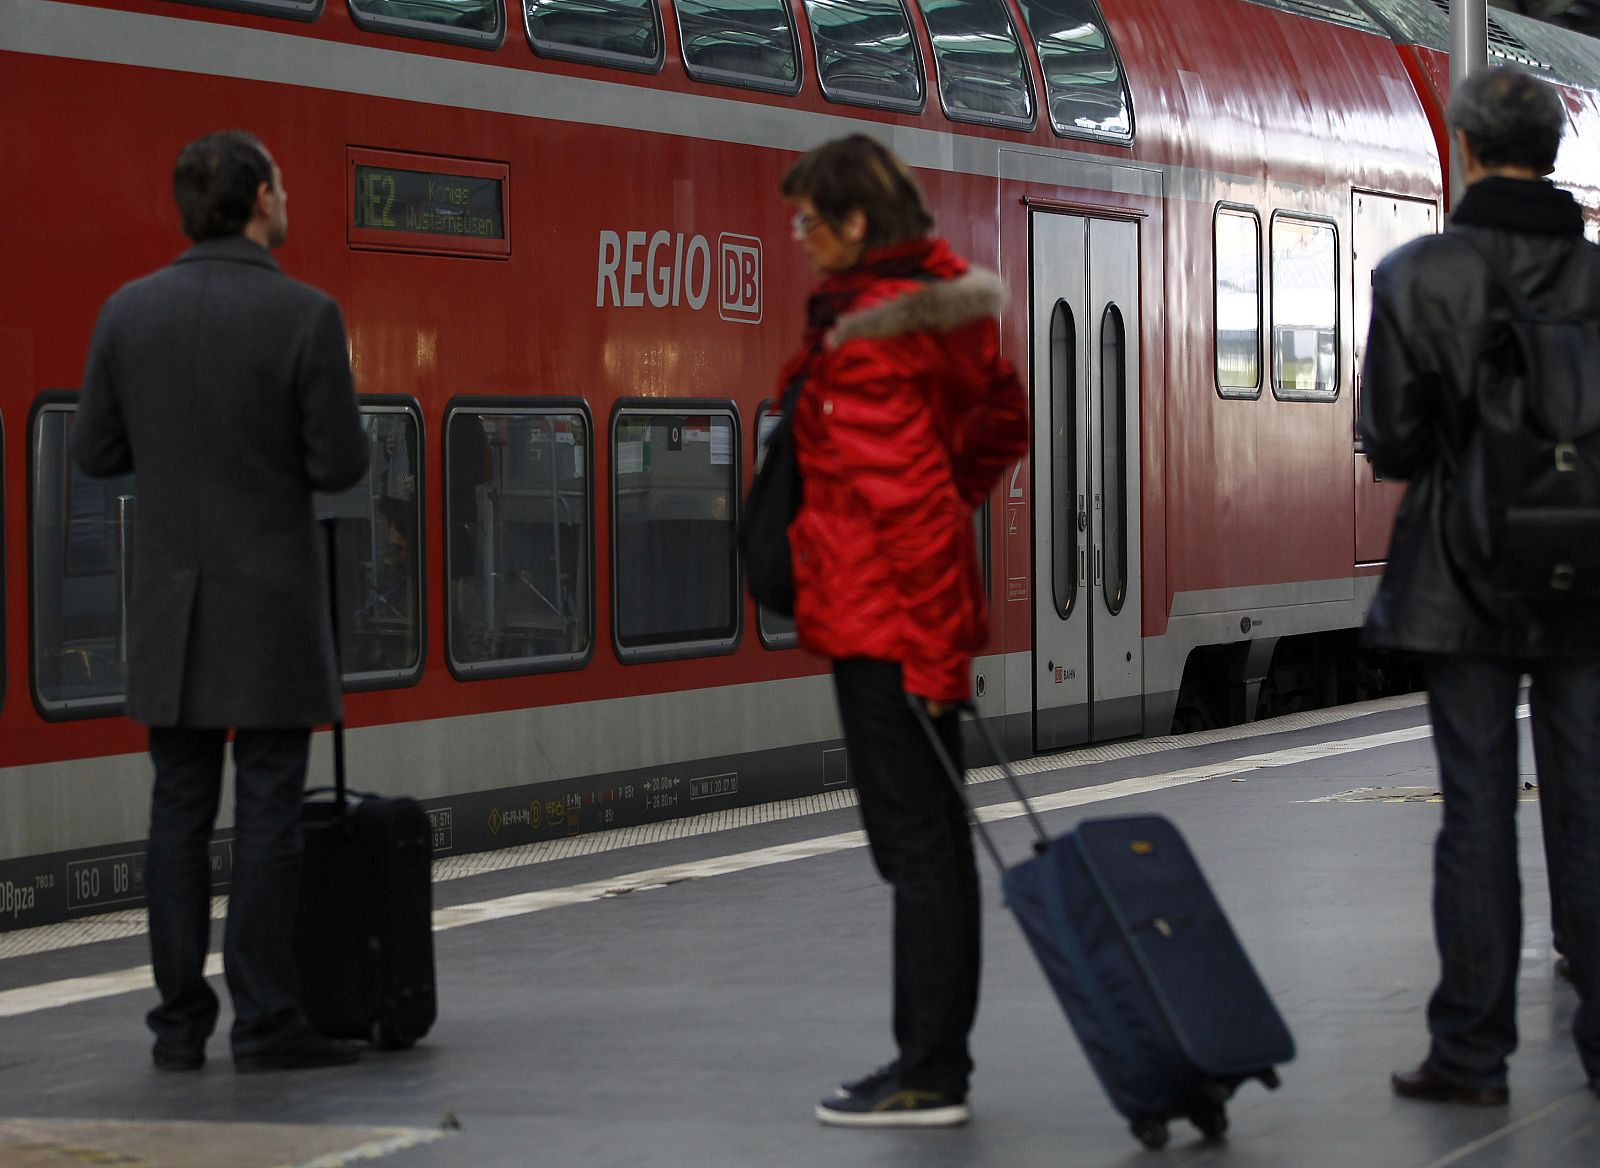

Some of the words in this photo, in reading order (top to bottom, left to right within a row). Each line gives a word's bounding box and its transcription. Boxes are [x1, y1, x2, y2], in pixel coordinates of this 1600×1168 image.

[596, 230, 711, 310] REGIO
[722, 242, 759, 314] DB
[1063, 669, 1076, 681] BAHN
[74, 867, 100, 900] 160
[113, 862, 129, 894] DB
